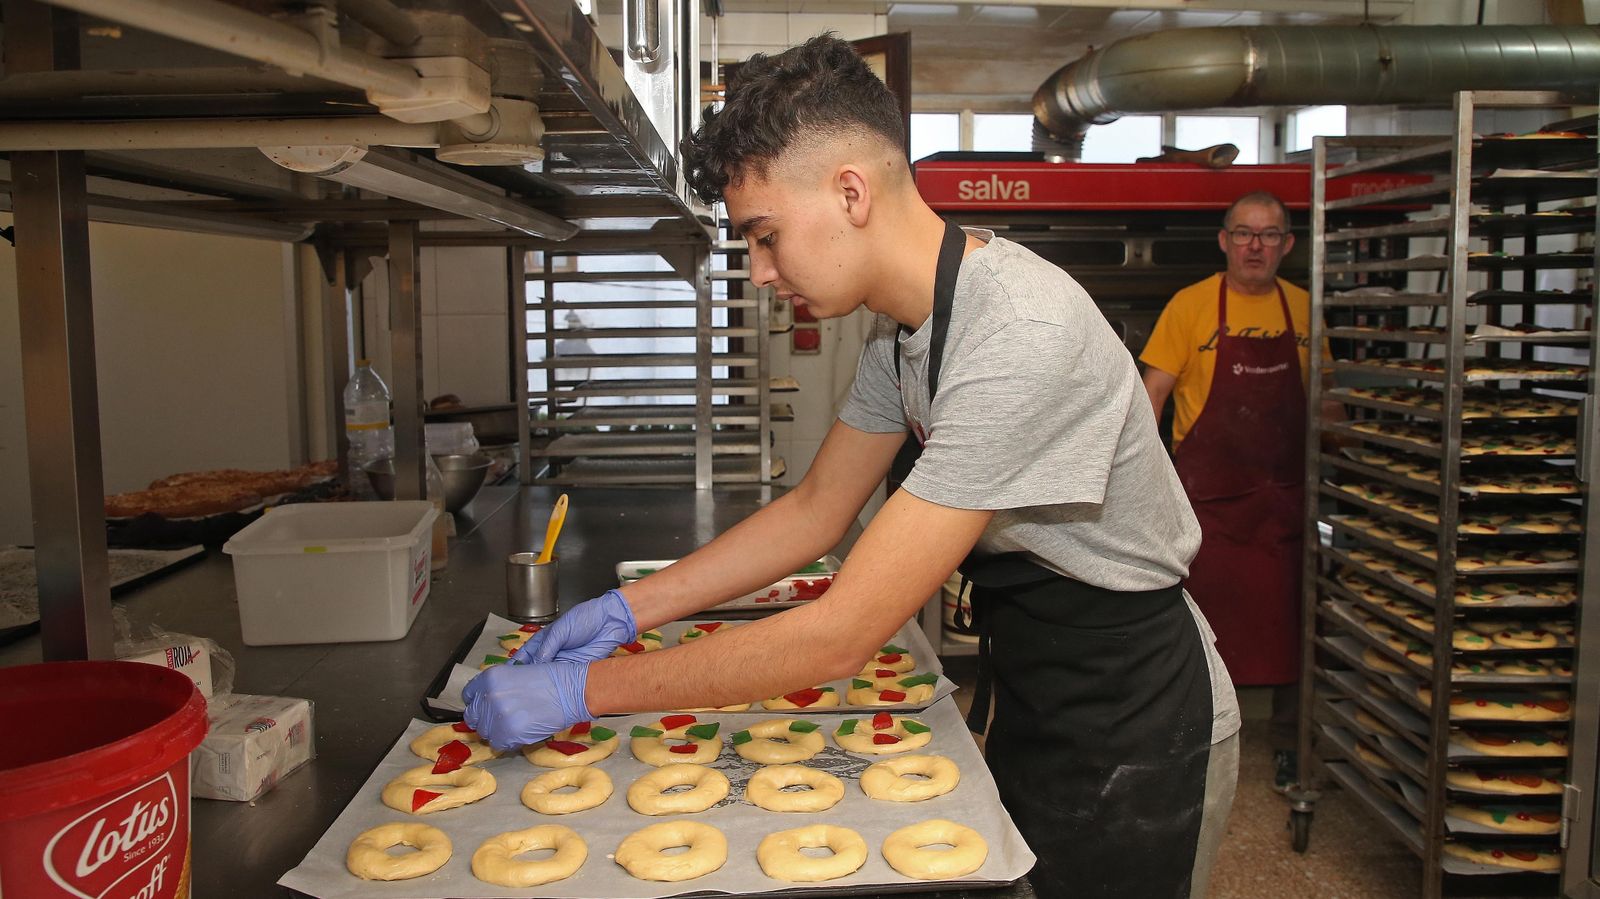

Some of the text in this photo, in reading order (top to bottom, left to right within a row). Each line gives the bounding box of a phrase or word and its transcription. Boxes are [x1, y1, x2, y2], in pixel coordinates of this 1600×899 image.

[958, 173, 1031, 201] salva
[173, 645, 194, 668] ROJA
[75, 796, 169, 878] Lotus
[123, 832, 165, 863] Since 1932
